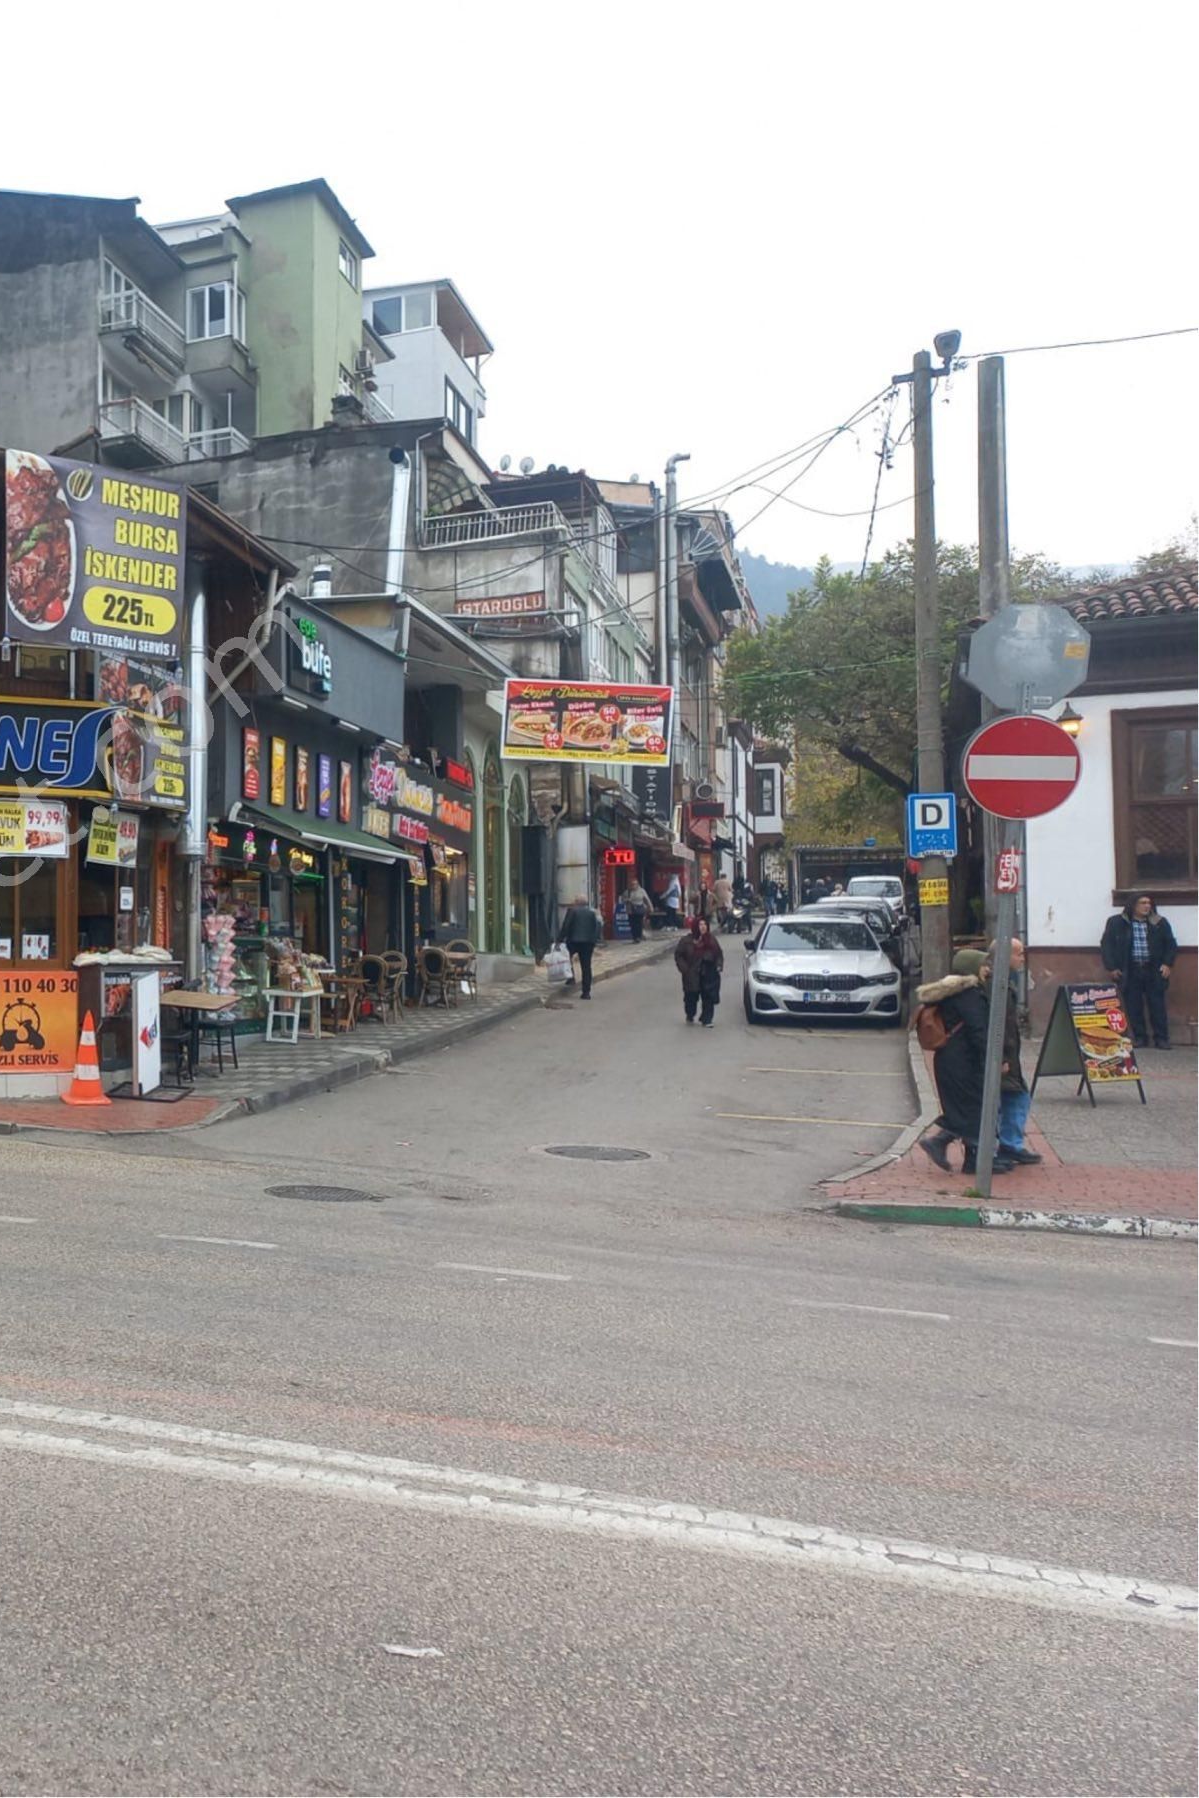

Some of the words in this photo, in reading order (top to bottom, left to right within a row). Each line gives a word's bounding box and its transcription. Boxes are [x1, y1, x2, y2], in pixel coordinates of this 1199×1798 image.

[101, 478, 180, 519] MEŞHUR
[114, 518, 179, 555] BURSA
[84, 545, 177, 591] İSKENDER
[70, 627, 91, 645] ÖZEL
[92, 632, 137, 651] TEREYAĞLI
[138, 637, 171, 656] SERVİS
[302, 635, 332, 679] büfe
[921, 803, 943, 826] D
[3, 978, 32, 993] 110
[36, 978, 56, 993] 40
[60, 978, 78, 993] 30
[17, 1049, 59, 1066] SERVİS
